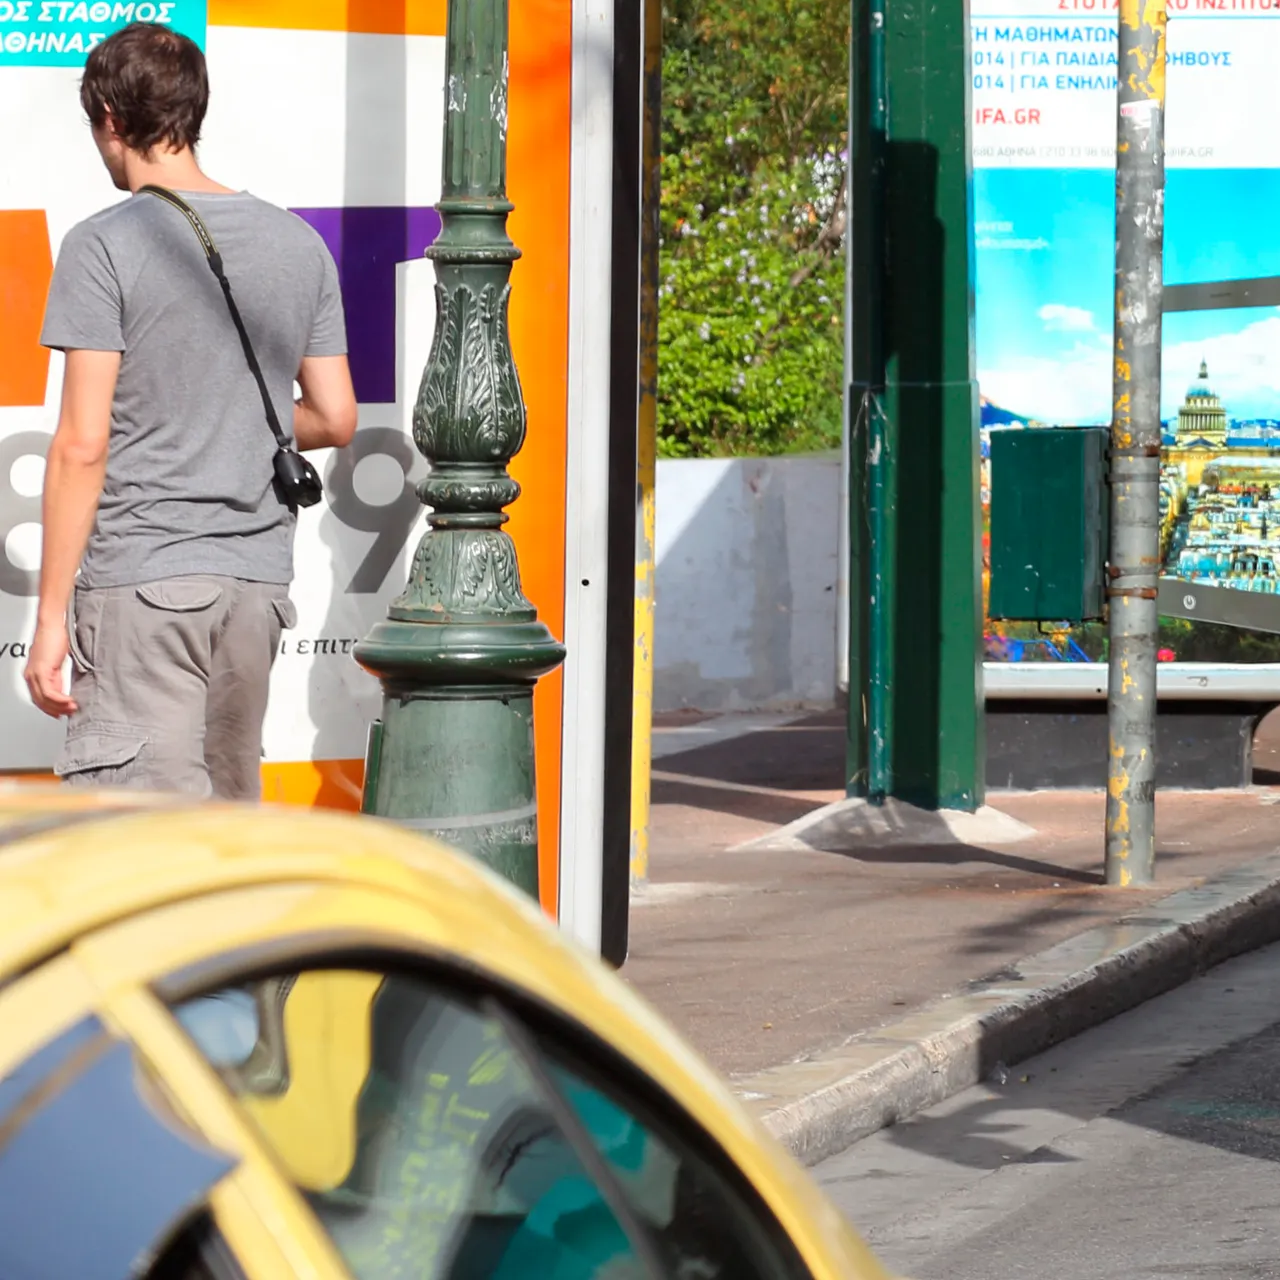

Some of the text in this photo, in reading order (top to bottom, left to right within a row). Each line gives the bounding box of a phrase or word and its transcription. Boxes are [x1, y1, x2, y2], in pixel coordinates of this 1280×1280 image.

[37, 1, 176, 23] ΣΤΑΘΜΟΣ
[0, 31, 106, 53] ΘΗΝΑΣ
[995, 26, 1119, 43] ΜΑΘΗΜΑΤΩΝ
[1020, 51, 1050, 66] ΓΙΑ
[1056, 51, 1118, 67] ΠΑΙΔΙΑ
[1020, 74, 1049, 89] ΓΙΑ
[1056, 74, 1118, 90] ΕΝΗΛΙΚ
[296, 638, 358, 656] επιτ
